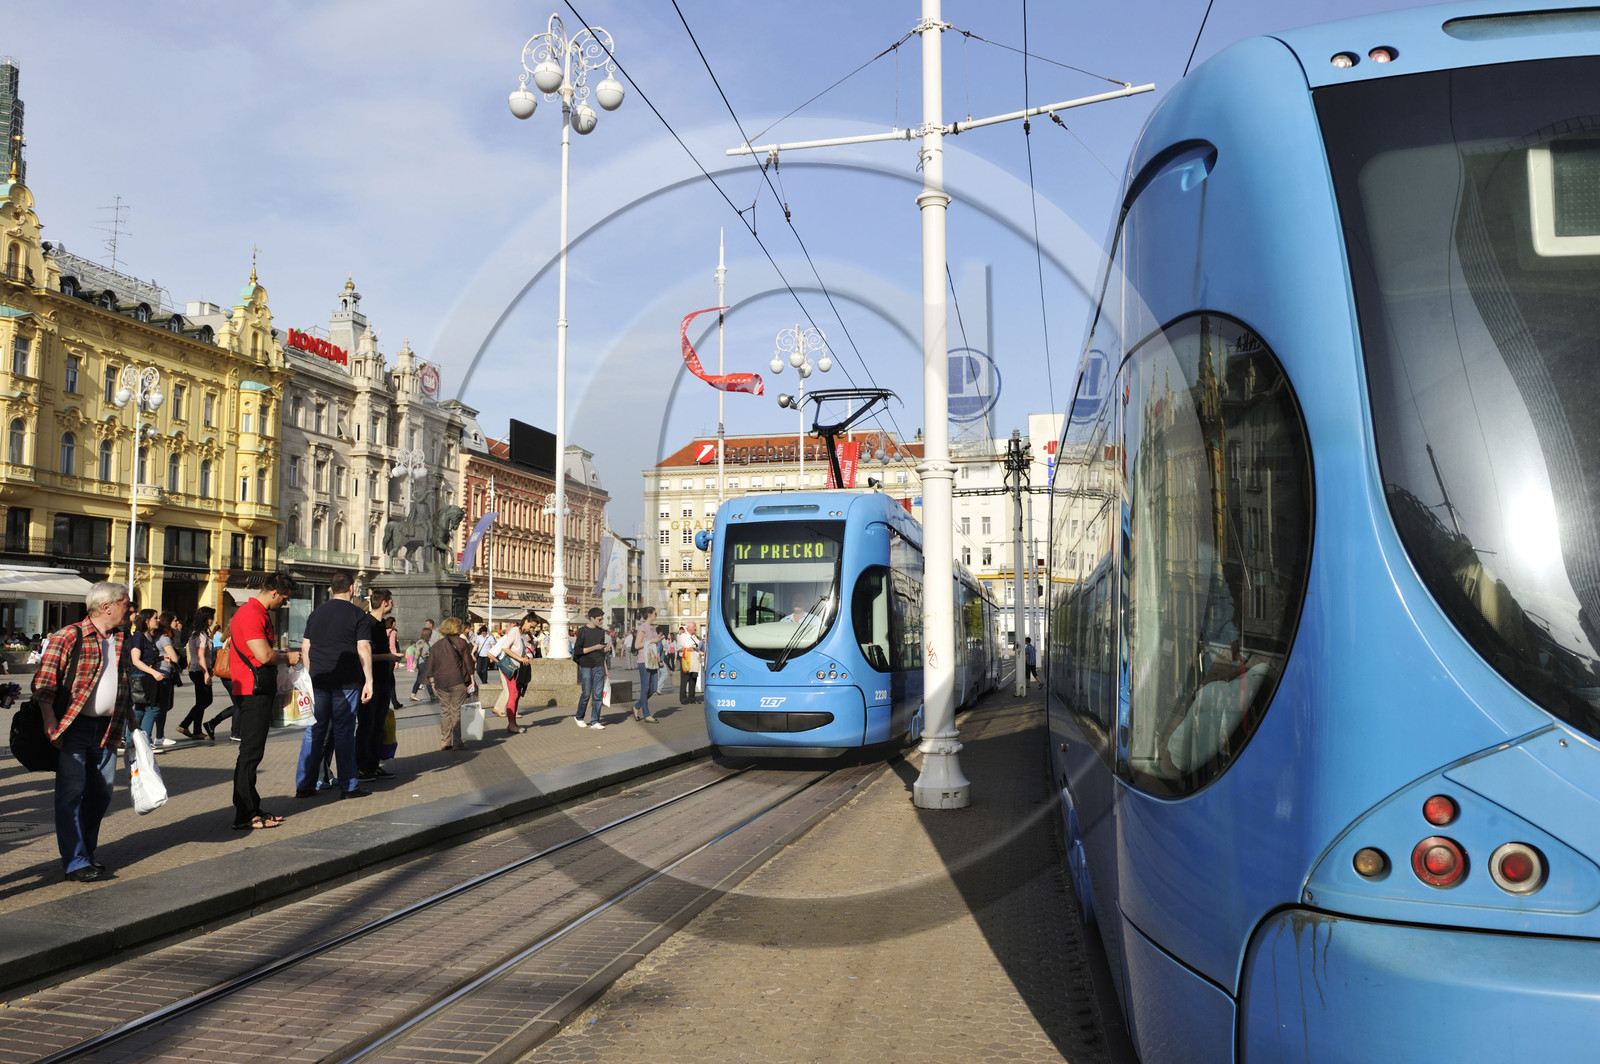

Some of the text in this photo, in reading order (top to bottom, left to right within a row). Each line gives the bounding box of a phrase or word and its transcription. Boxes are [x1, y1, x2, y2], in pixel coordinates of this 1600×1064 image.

[288, 328, 347, 366] KONZUM
[736, 543, 824, 559] 17 PRECKO
[875, 689, 887, 700] 2230
[298, 696, 310, 707] 60
[717, 697, 786, 708] 2230 ZET
